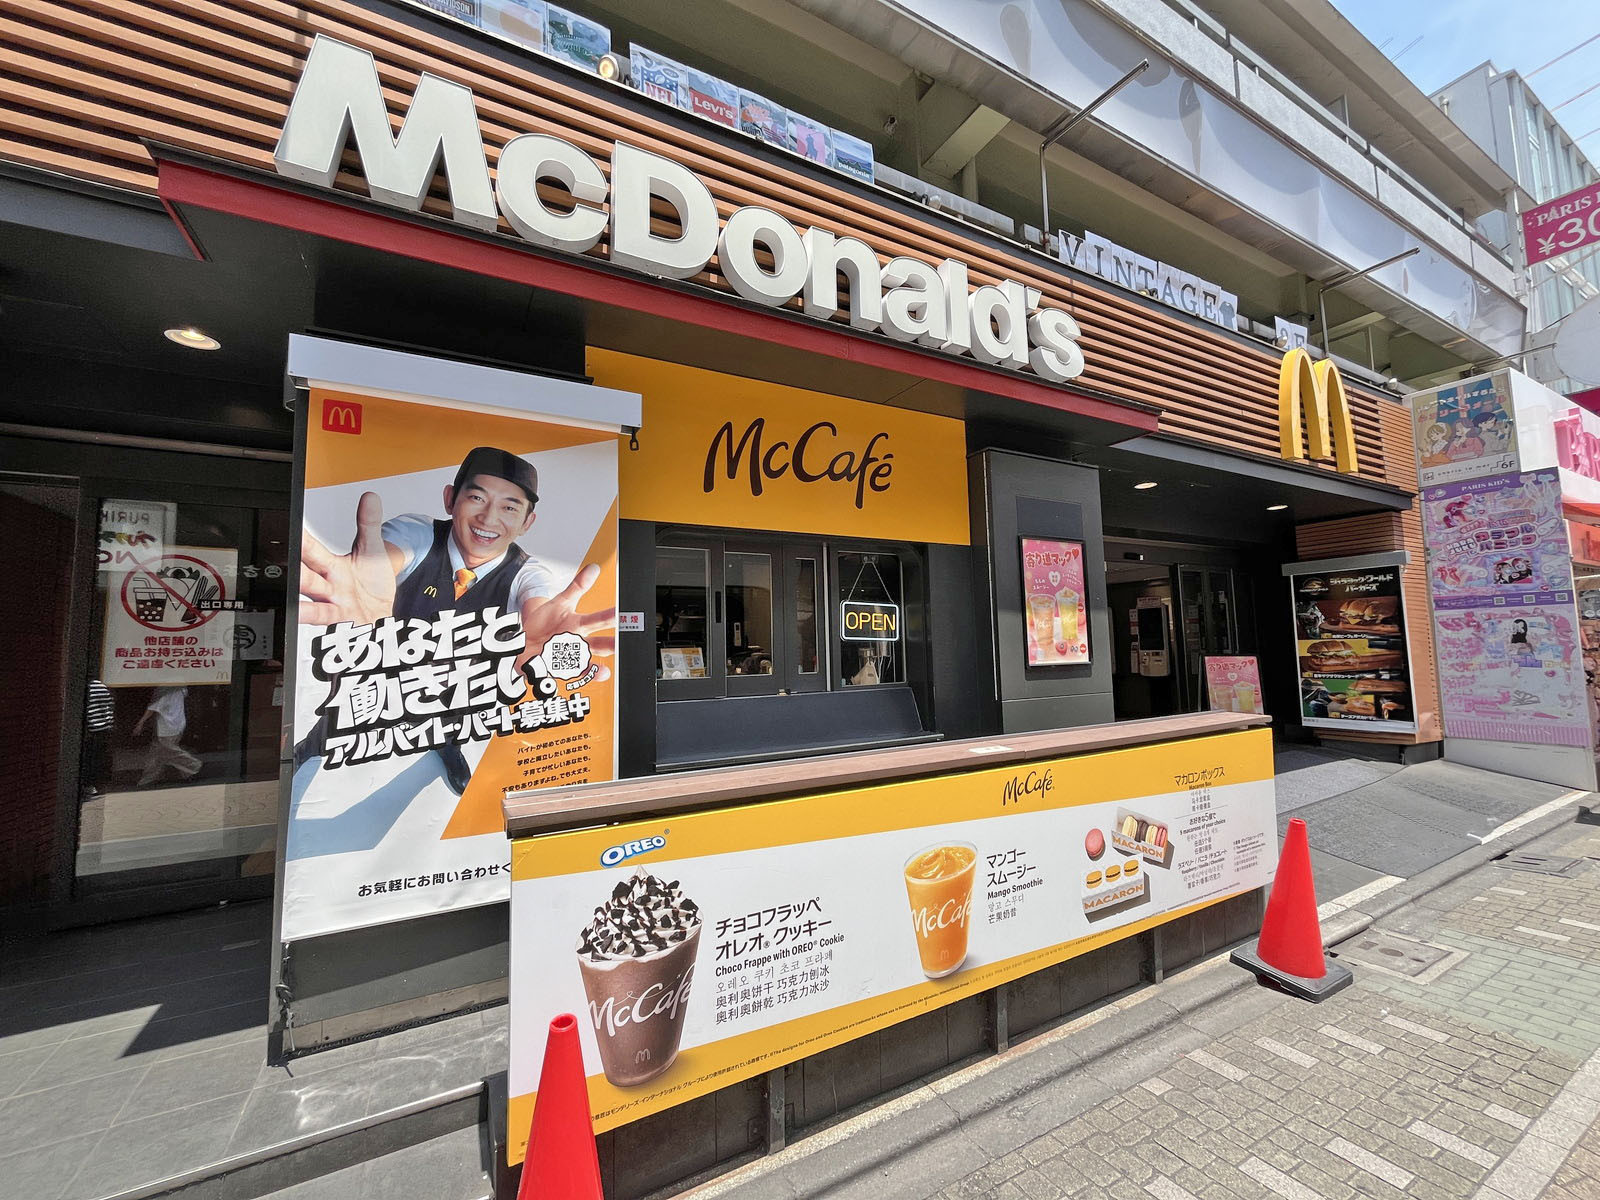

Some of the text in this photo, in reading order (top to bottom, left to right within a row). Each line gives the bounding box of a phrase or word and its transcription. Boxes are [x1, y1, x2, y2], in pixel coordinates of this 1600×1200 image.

[694, 96, 734, 119] Levi's
[838, 162, 870, 179] patagonia
[273, 33, 1085, 383] McDonald's
[1536, 194, 1592, 227] PARIS
[1061, 231, 1218, 325] VINTAGE
[704, 417, 894, 508] McCafé
[200, 601, 244, 609] 出口専用
[845, 611, 896, 631] OPEN
[115, 647, 224, 657] 商品お持ち込みは
[144, 636, 198, 646] 他店舗の
[321, 606, 526, 674] あなたと
[122, 659, 216, 669] ご遠慮ください
[327, 654, 558, 731] 働きたい。
[325, 695, 591, 764] アルバイト・パート募集中
[1003, 768, 1054, 806] McCafé
[1174, 766, 1225, 786] マカロンボックス
[600, 836, 666, 868] OREO
[986, 849, 1027, 869] マンゴー
[1111, 835, 1164, 859] MACARON
[986, 864, 1037, 888] スムージー
[987, 878, 1044, 901] Mango Smoothie
[1083, 883, 1144, 910] MACARON
[715, 897, 822, 939] チョコフラッペ
[773, 919, 832, 946] クッキー
[715, 962, 743, 977] Choco
[744, 953, 772, 970] Frappe
[773, 948, 791, 961] with
[819, 933, 845, 948] Cookie
